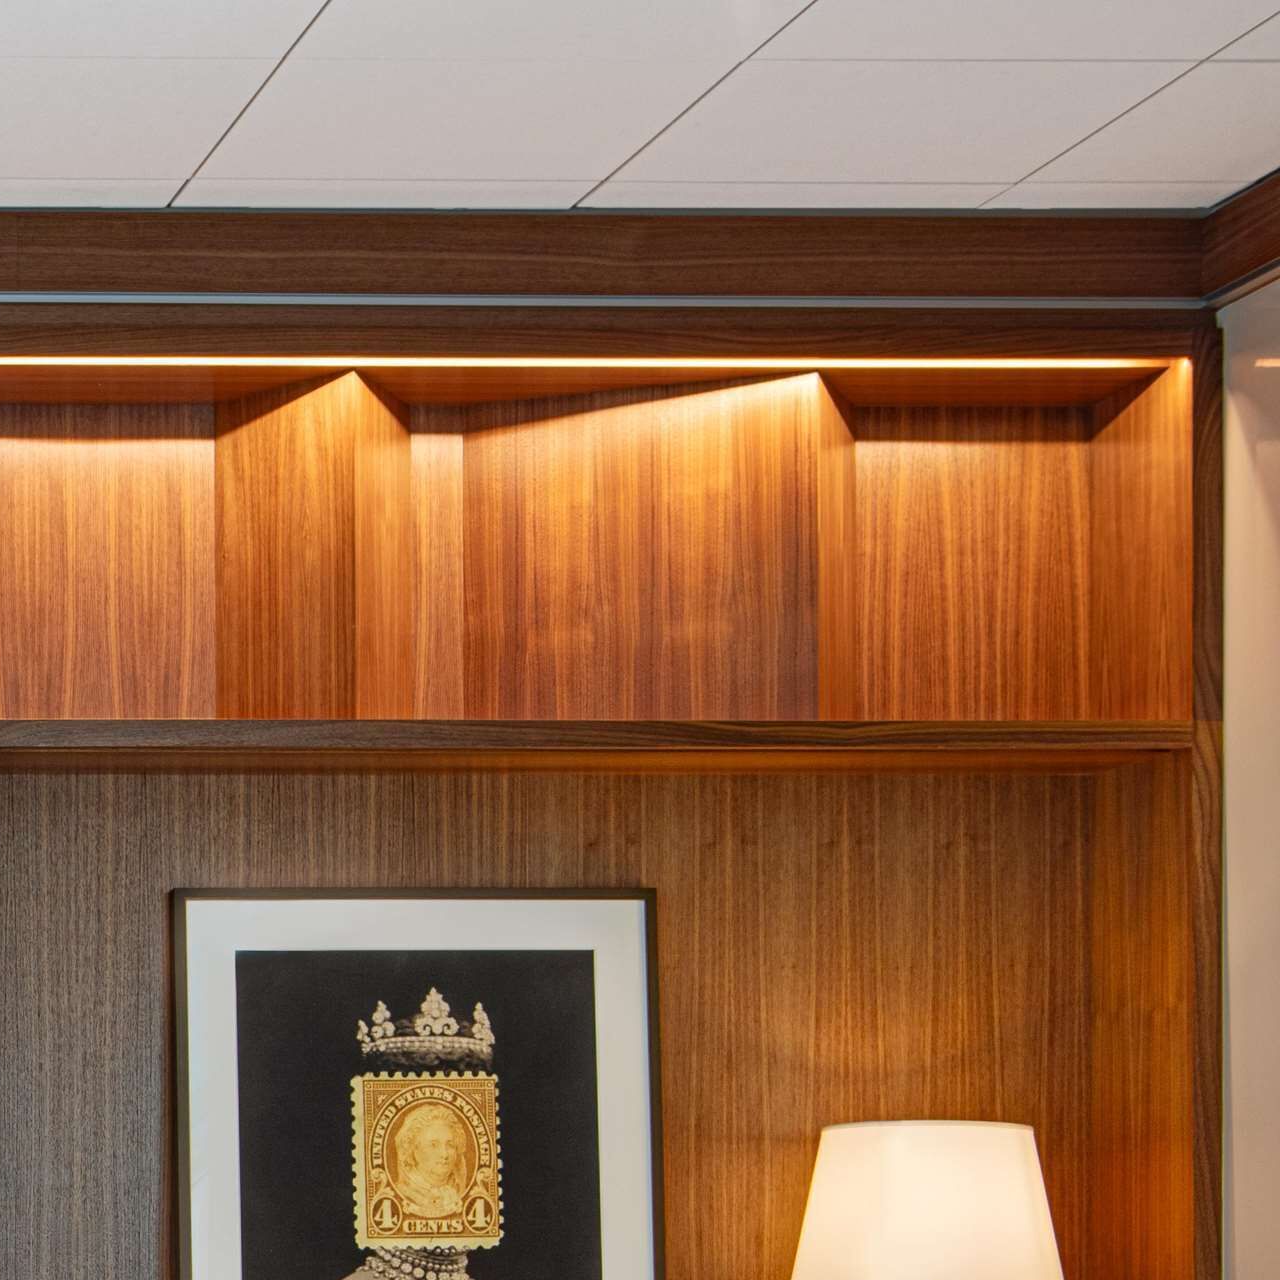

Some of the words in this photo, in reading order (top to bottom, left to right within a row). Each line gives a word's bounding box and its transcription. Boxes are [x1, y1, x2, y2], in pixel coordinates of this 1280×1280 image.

[395, 1088, 454, 1108] STATES
[455, 1096, 491, 1166] POSTAGE
[374, 1198, 398, 1229] 4
[403, 1219, 463, 1233] CENTS
[467, 1198, 491, 1229] 4
